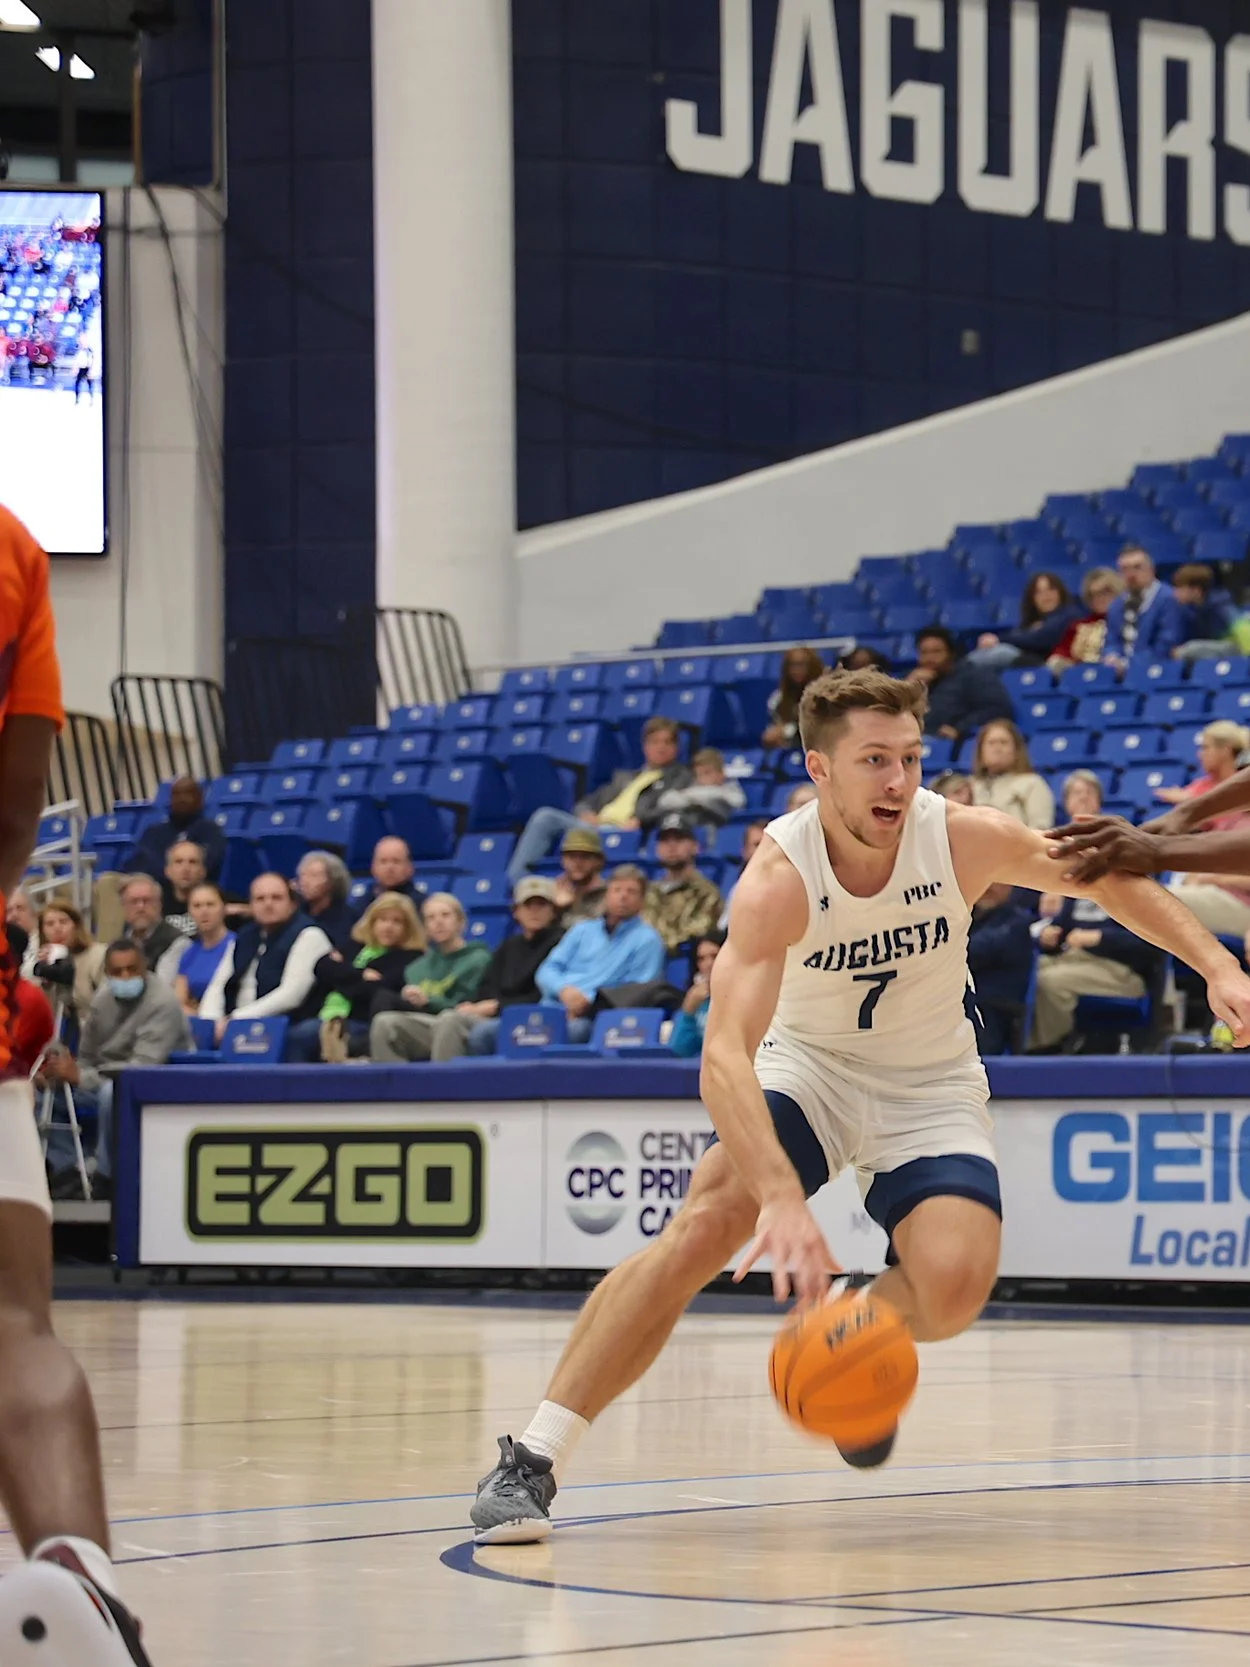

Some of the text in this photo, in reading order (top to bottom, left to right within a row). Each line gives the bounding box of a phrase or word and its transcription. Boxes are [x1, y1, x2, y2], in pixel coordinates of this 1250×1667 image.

[903, 881, 943, 905] PBC
[803, 916, 950, 972] AUGUSTA
[853, 969, 898, 1030] 7
[568, 1168, 625, 1198] CPC
